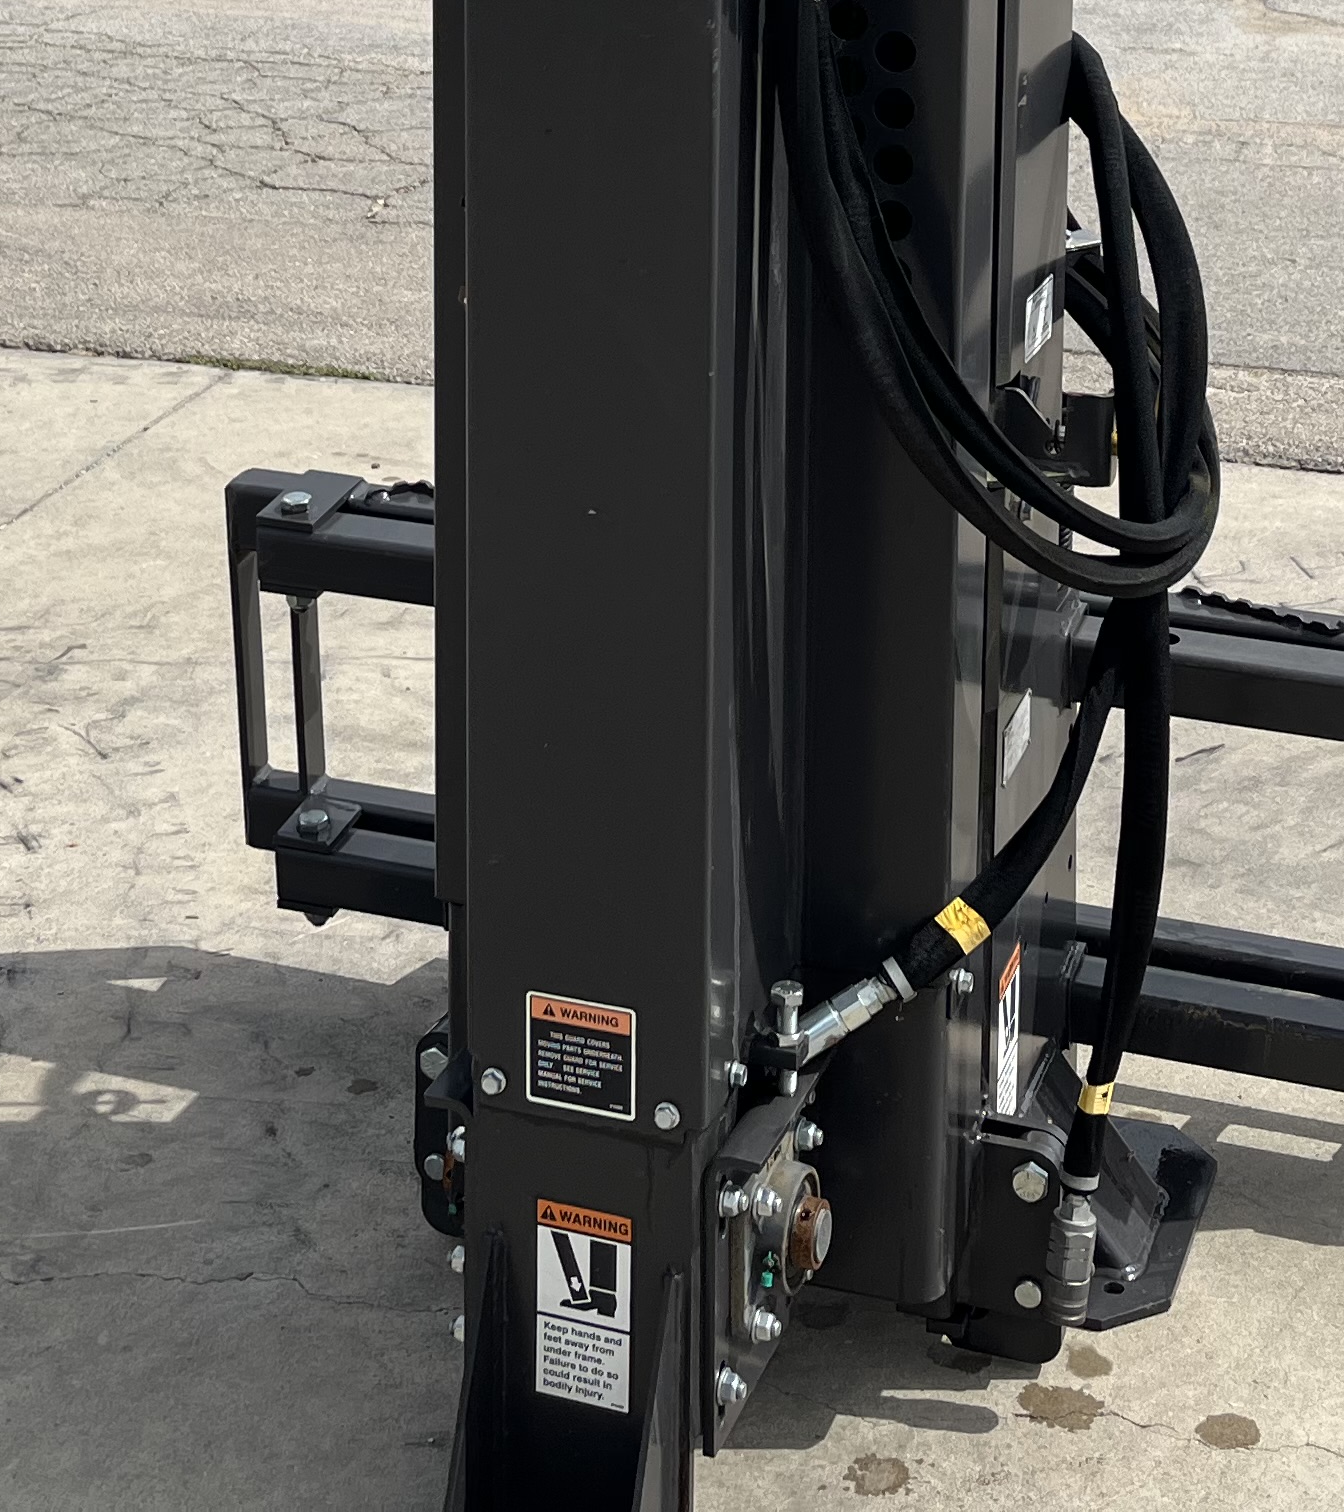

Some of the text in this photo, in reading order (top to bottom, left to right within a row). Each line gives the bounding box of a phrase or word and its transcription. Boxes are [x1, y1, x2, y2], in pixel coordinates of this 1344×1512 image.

[560, 1007, 619, 1028] WARNING
[562, 1043, 582, 1055] PARTS
[586, 1038, 611, 1049] COVERS
[559, 1208, 629, 1236] WARNING
[543, 1320, 623, 1347] Keep hands and
[543, 1331, 615, 1357] feet away from
[543, 1345, 606, 1366] under frame.
[543, 1354, 619, 1381] Failure to do so
[543, 1367, 613, 1391] could result in
[543, 1377, 605, 1401] bodily injury.
